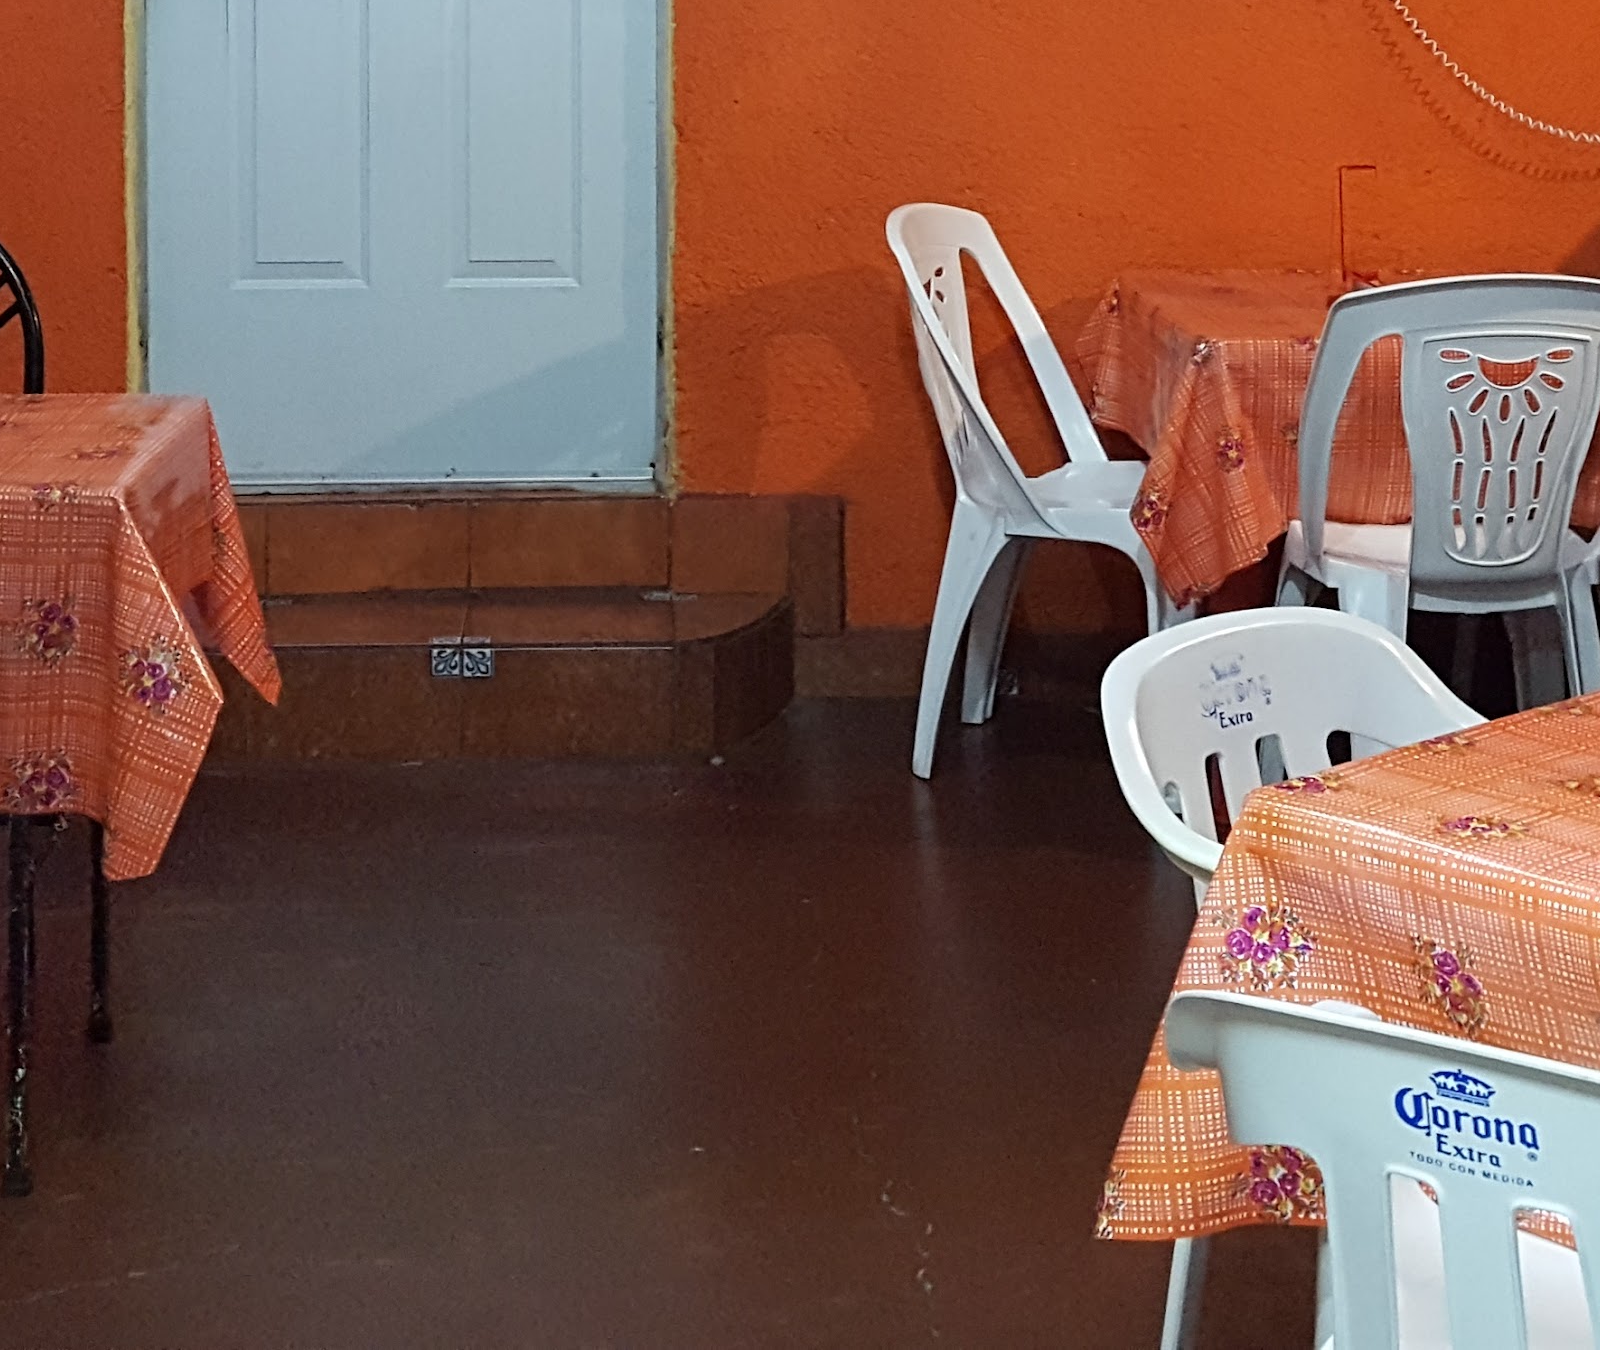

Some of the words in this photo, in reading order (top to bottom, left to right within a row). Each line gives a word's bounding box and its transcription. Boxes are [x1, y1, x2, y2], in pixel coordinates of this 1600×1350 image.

[1218, 710, 1254, 730] Extra
[1394, 1087, 1540, 1152] Corona
[1408, 1150, 1444, 1168] TODO
[1448, 1161, 1476, 1177] CON
[1481, 1170, 1535, 1188] MEDIDA
[1435, 1132, 1503, 1169] Extra
